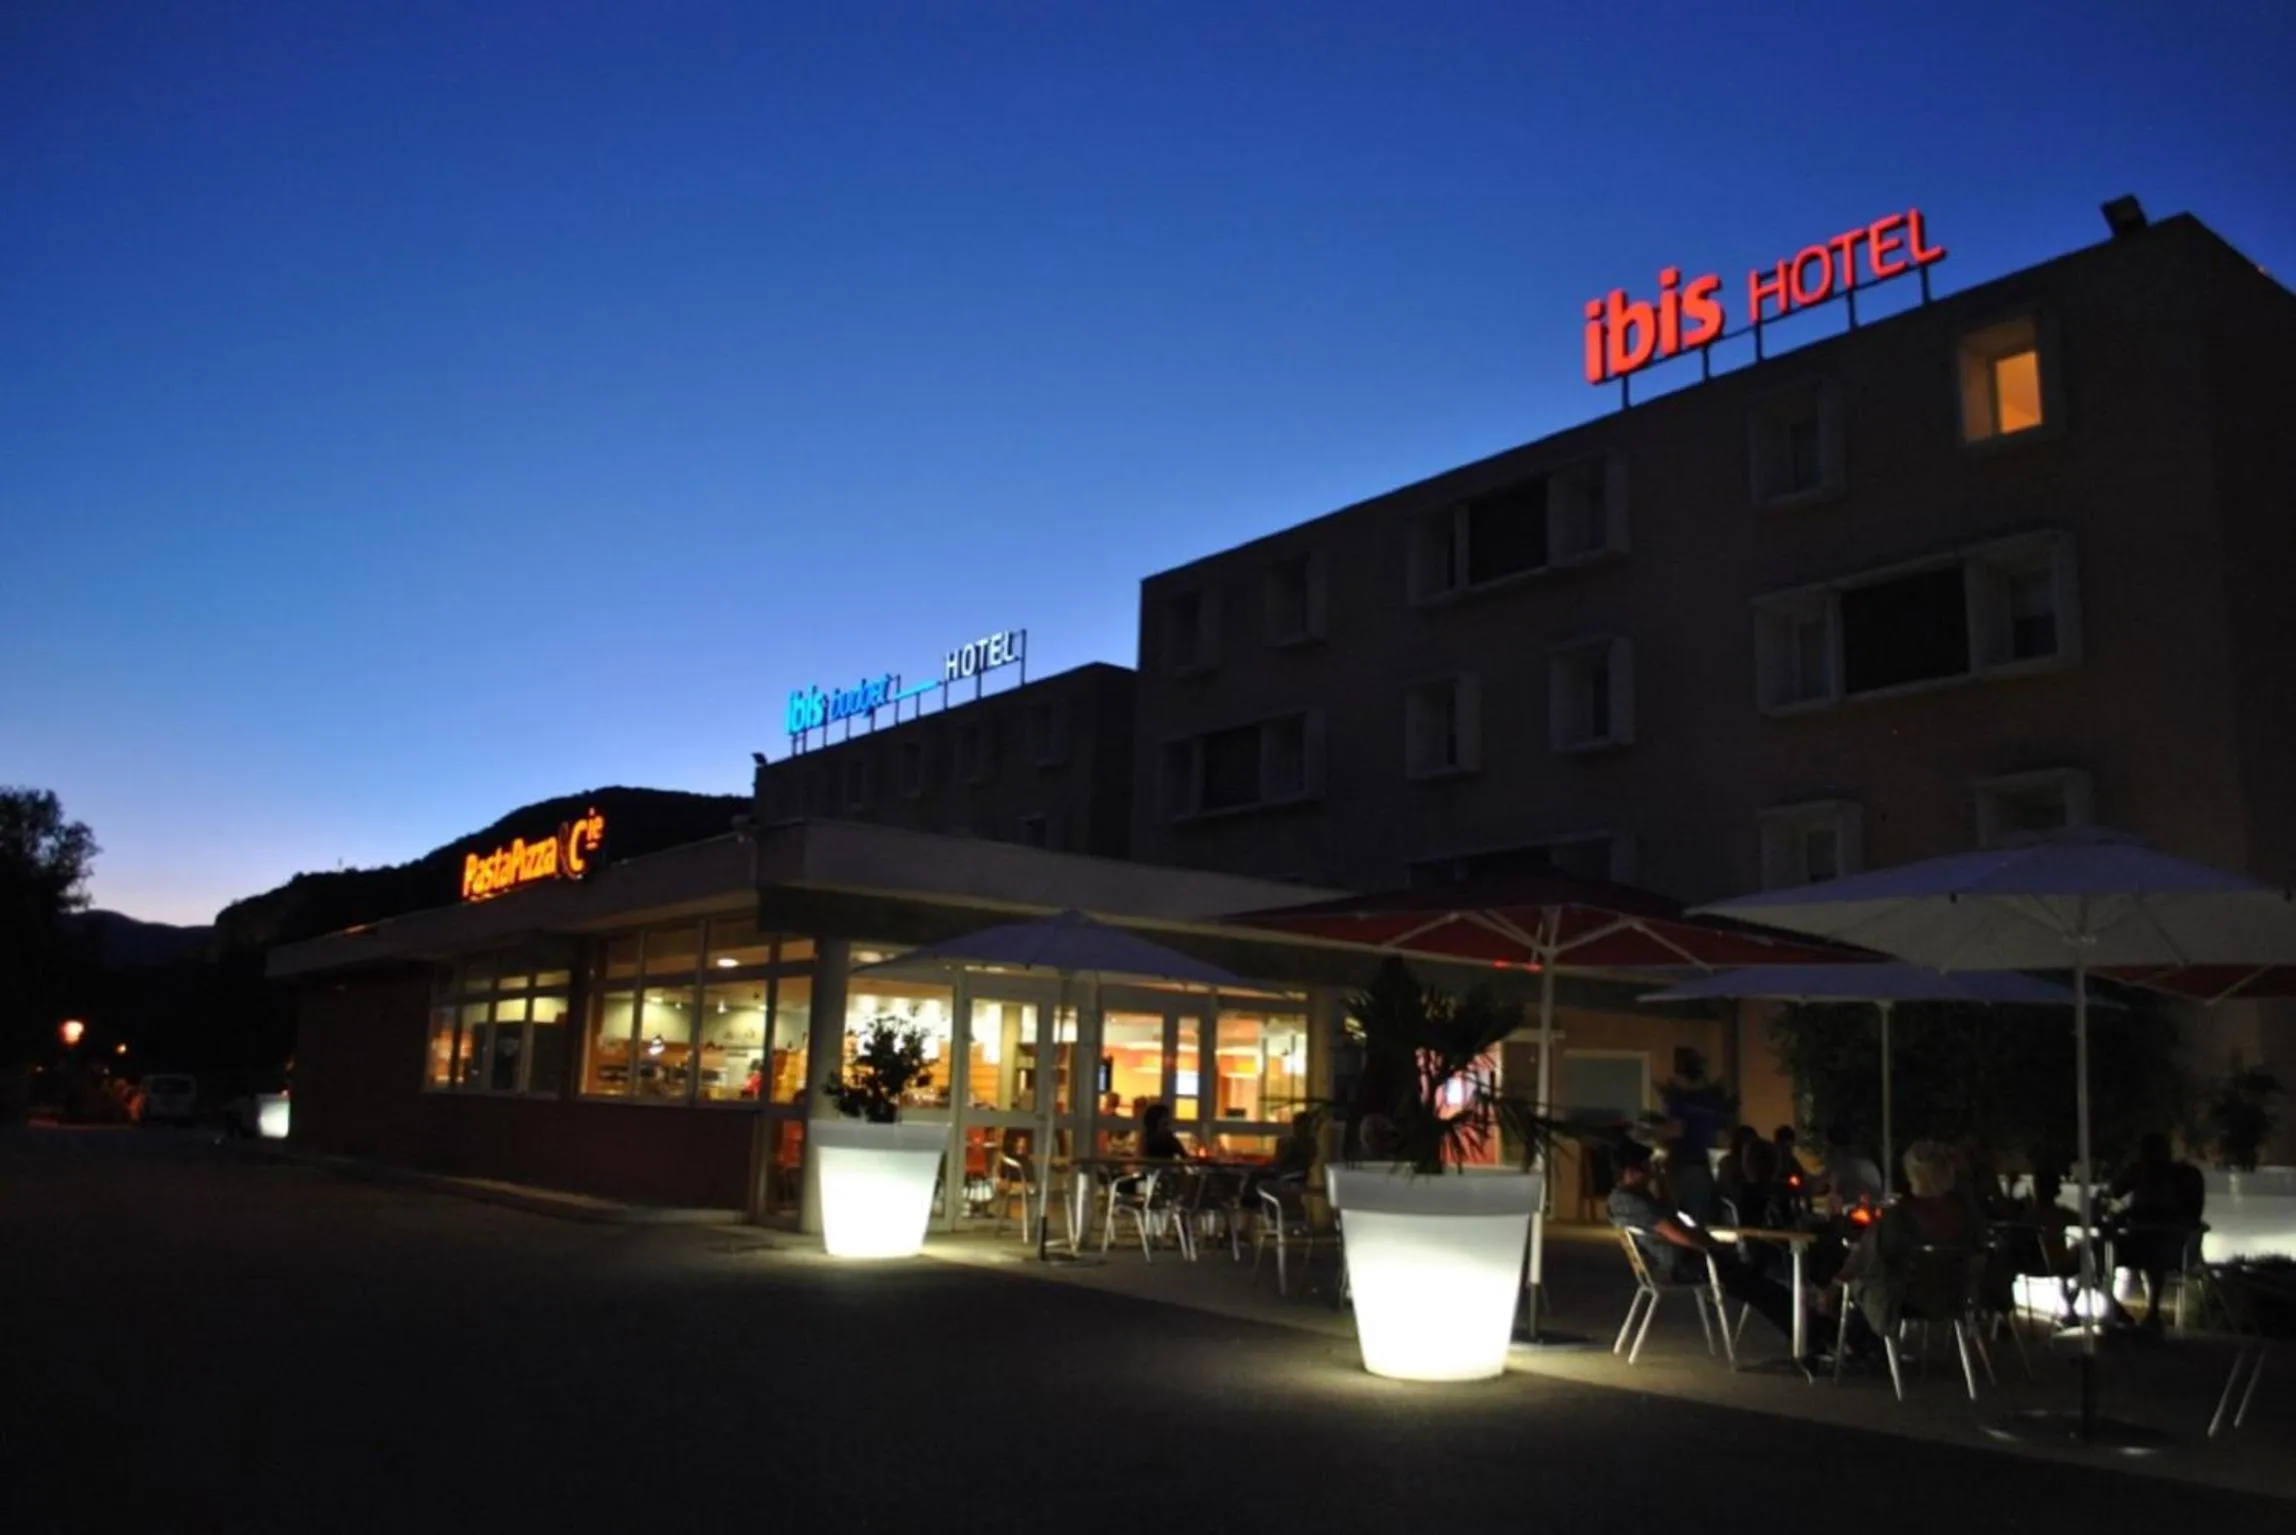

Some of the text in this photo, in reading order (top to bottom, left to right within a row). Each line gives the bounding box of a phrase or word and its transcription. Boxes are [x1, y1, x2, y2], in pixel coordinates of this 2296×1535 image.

[1584, 207, 1946, 385] ibis HOTEL
[785, 683, 829, 736] ibis
[944, 630, 1018, 680] HOTEL
